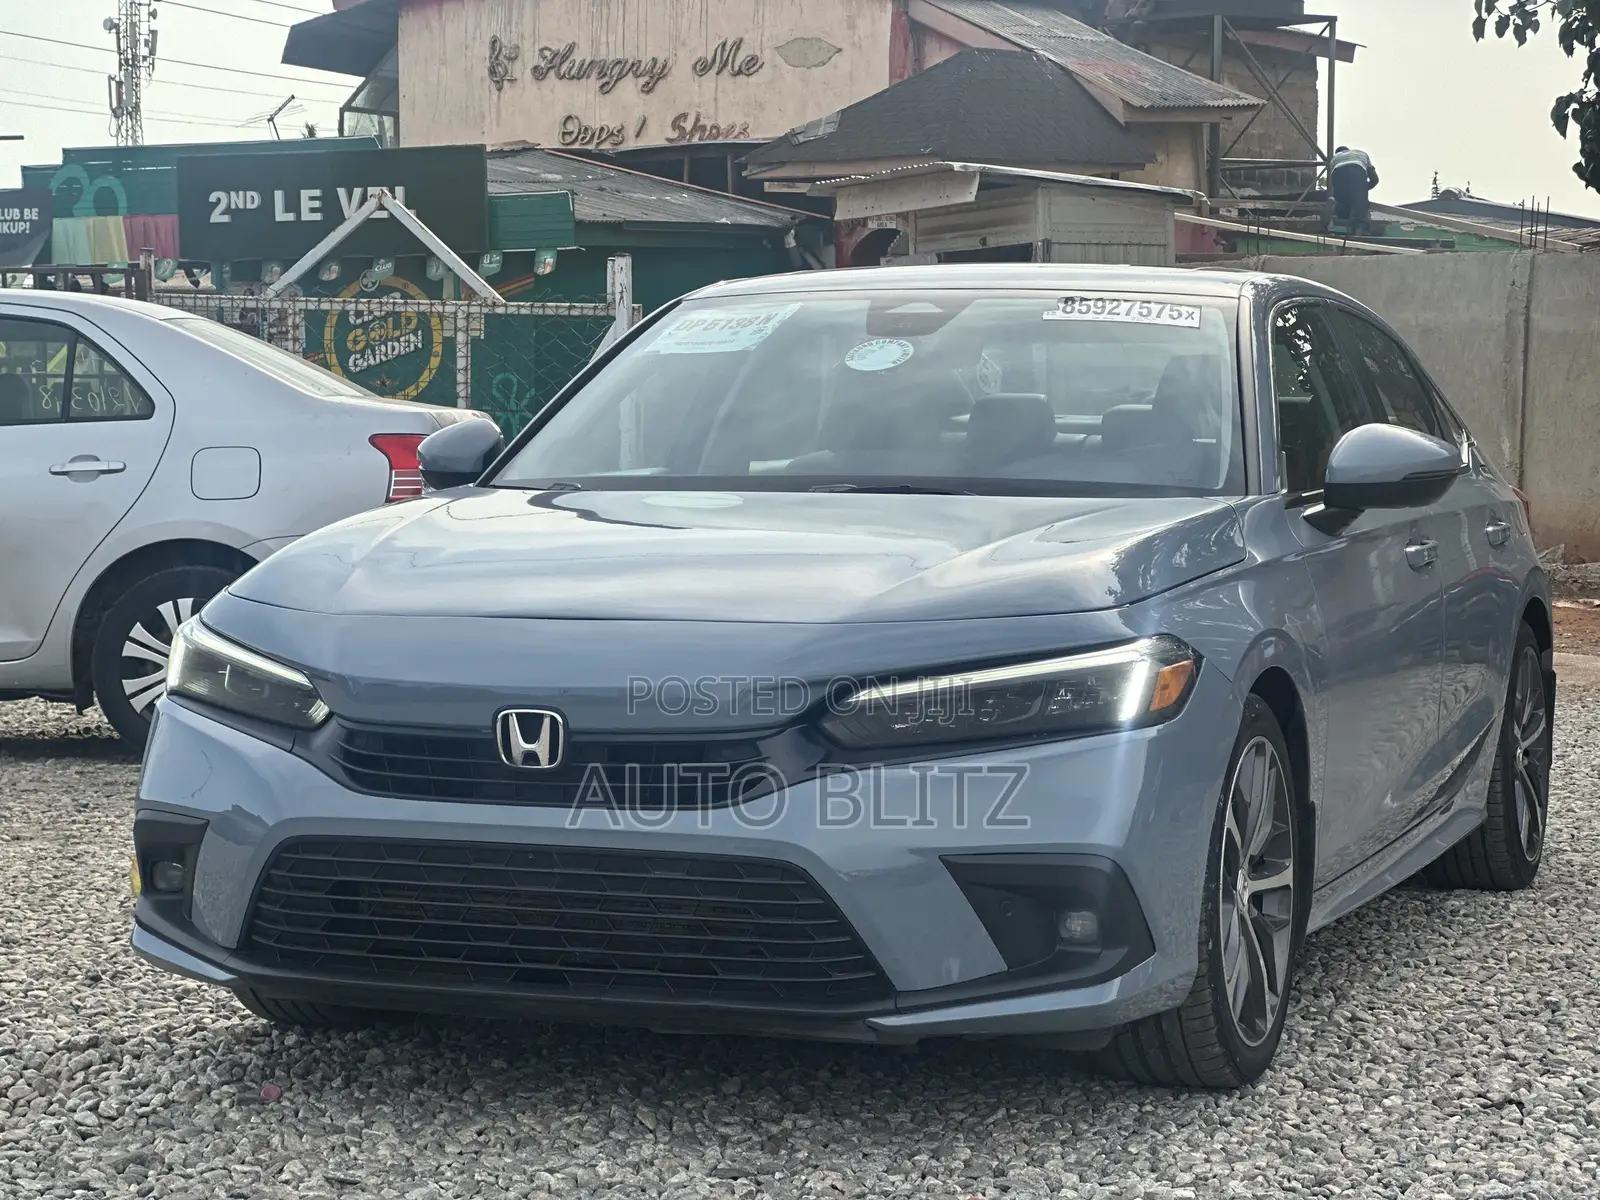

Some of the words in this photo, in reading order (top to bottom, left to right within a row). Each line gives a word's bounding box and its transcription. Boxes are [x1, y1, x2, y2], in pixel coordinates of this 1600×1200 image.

[530, 41, 671, 94] Hungry
[692, 36, 764, 77] Me
[557, 112, 625, 147] Oops
[23, 207, 39, 220] BE
[208, 190, 262, 223] 2ND
[346, 311, 418, 352] GOLD
[348, 329, 423, 373] GARDEN
